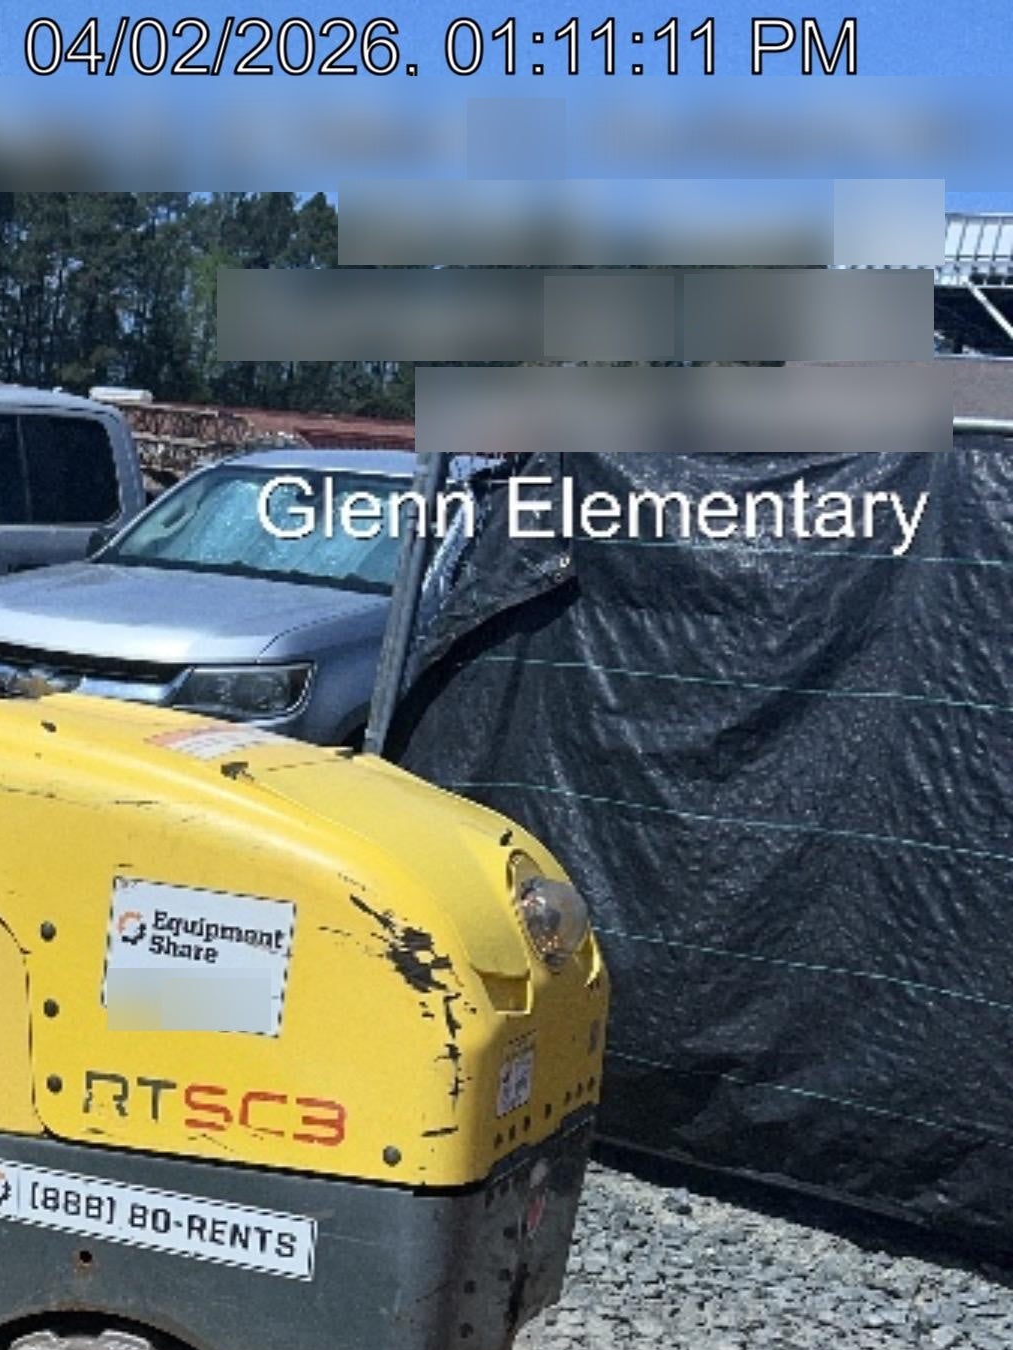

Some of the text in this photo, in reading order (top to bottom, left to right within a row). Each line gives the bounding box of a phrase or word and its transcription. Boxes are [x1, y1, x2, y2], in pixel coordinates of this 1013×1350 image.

[148, 934, 219, 964] Share
[151, 909, 284, 950] Equipment
[128, 1203, 297, 1259] 80-RENTS
